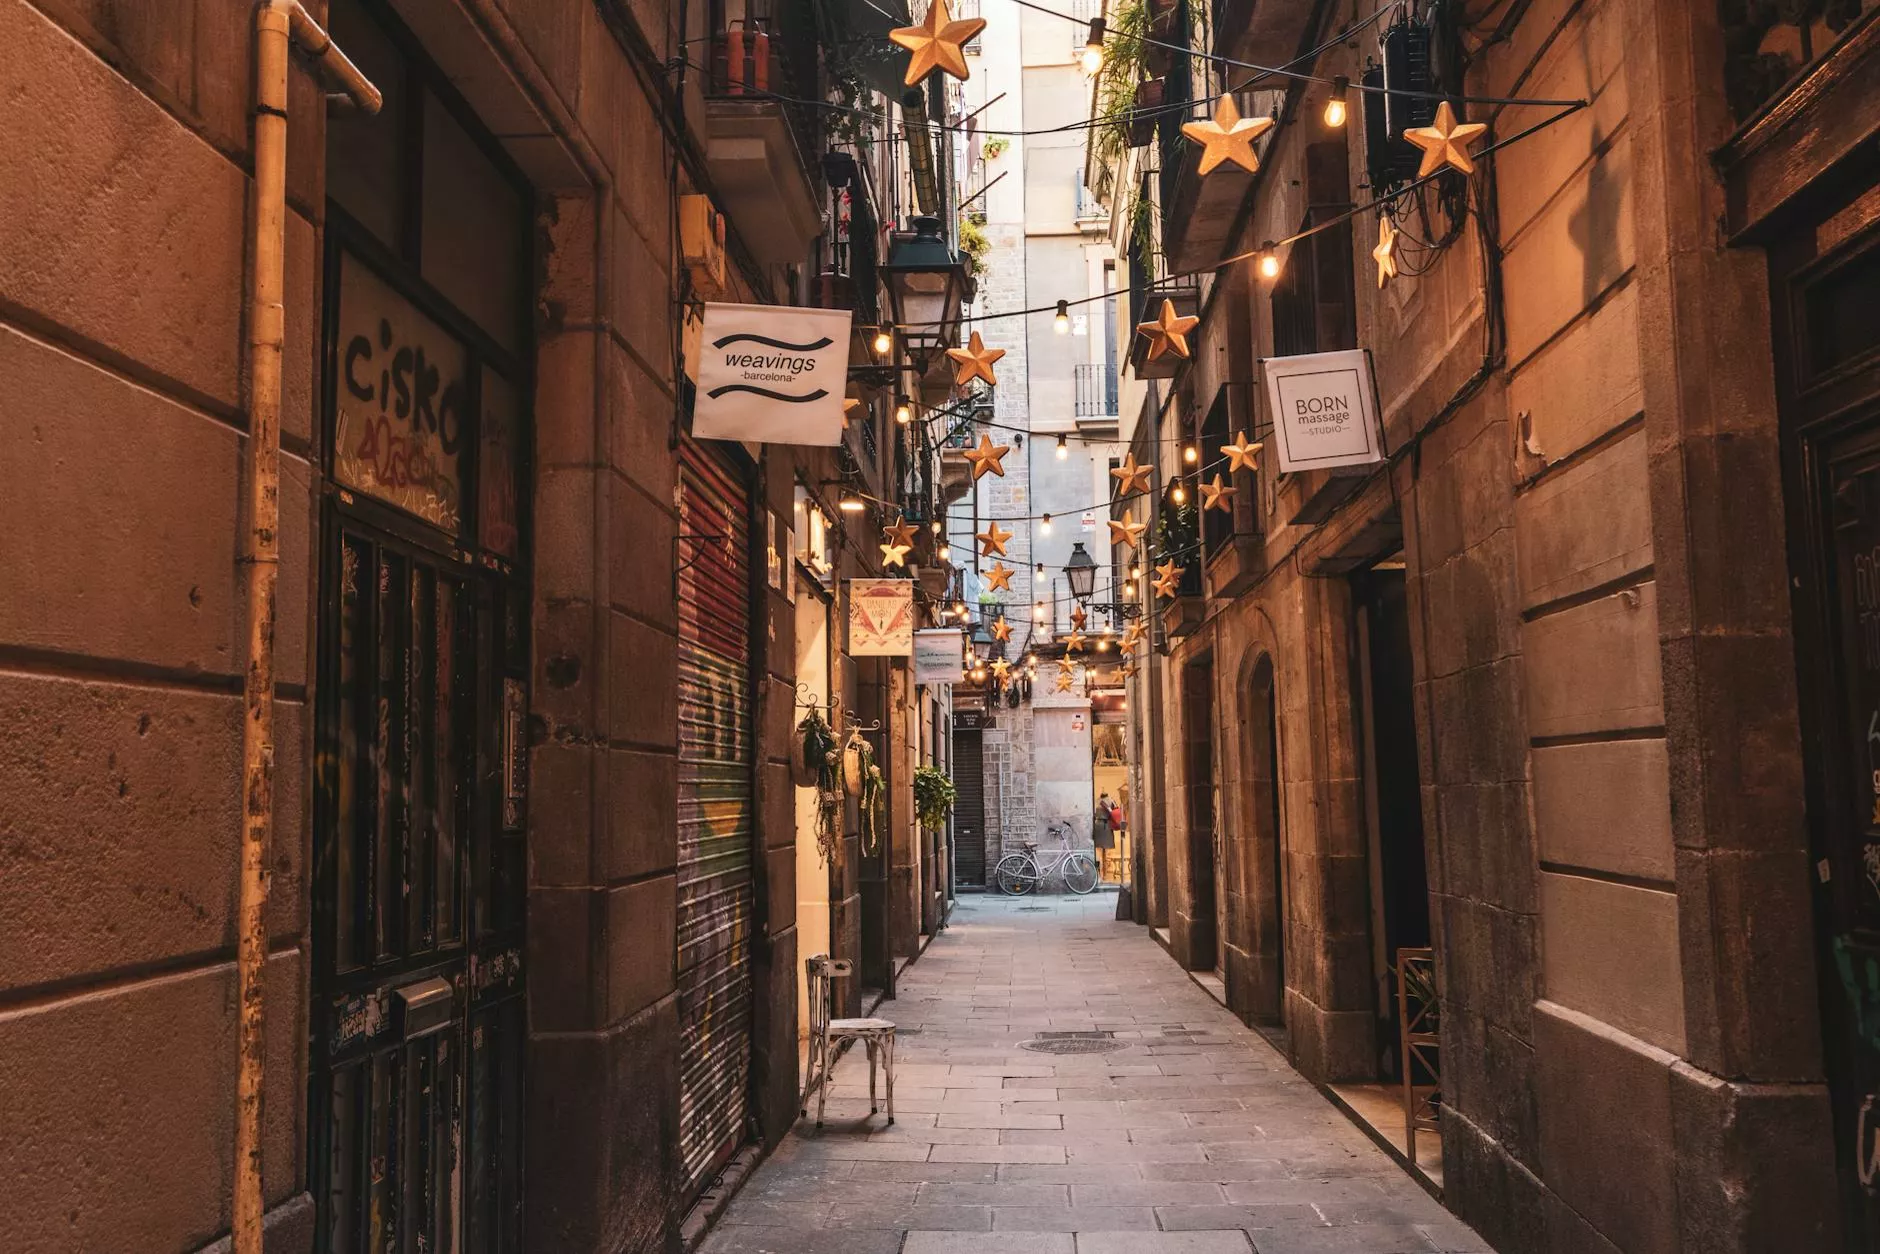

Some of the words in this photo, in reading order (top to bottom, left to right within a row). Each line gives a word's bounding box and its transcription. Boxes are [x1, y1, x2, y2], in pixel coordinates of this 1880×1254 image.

[725, 352, 816, 374] weavings
[1296, 394, 1348, 415] BORN
[1298, 411, 1350, 425] massage
